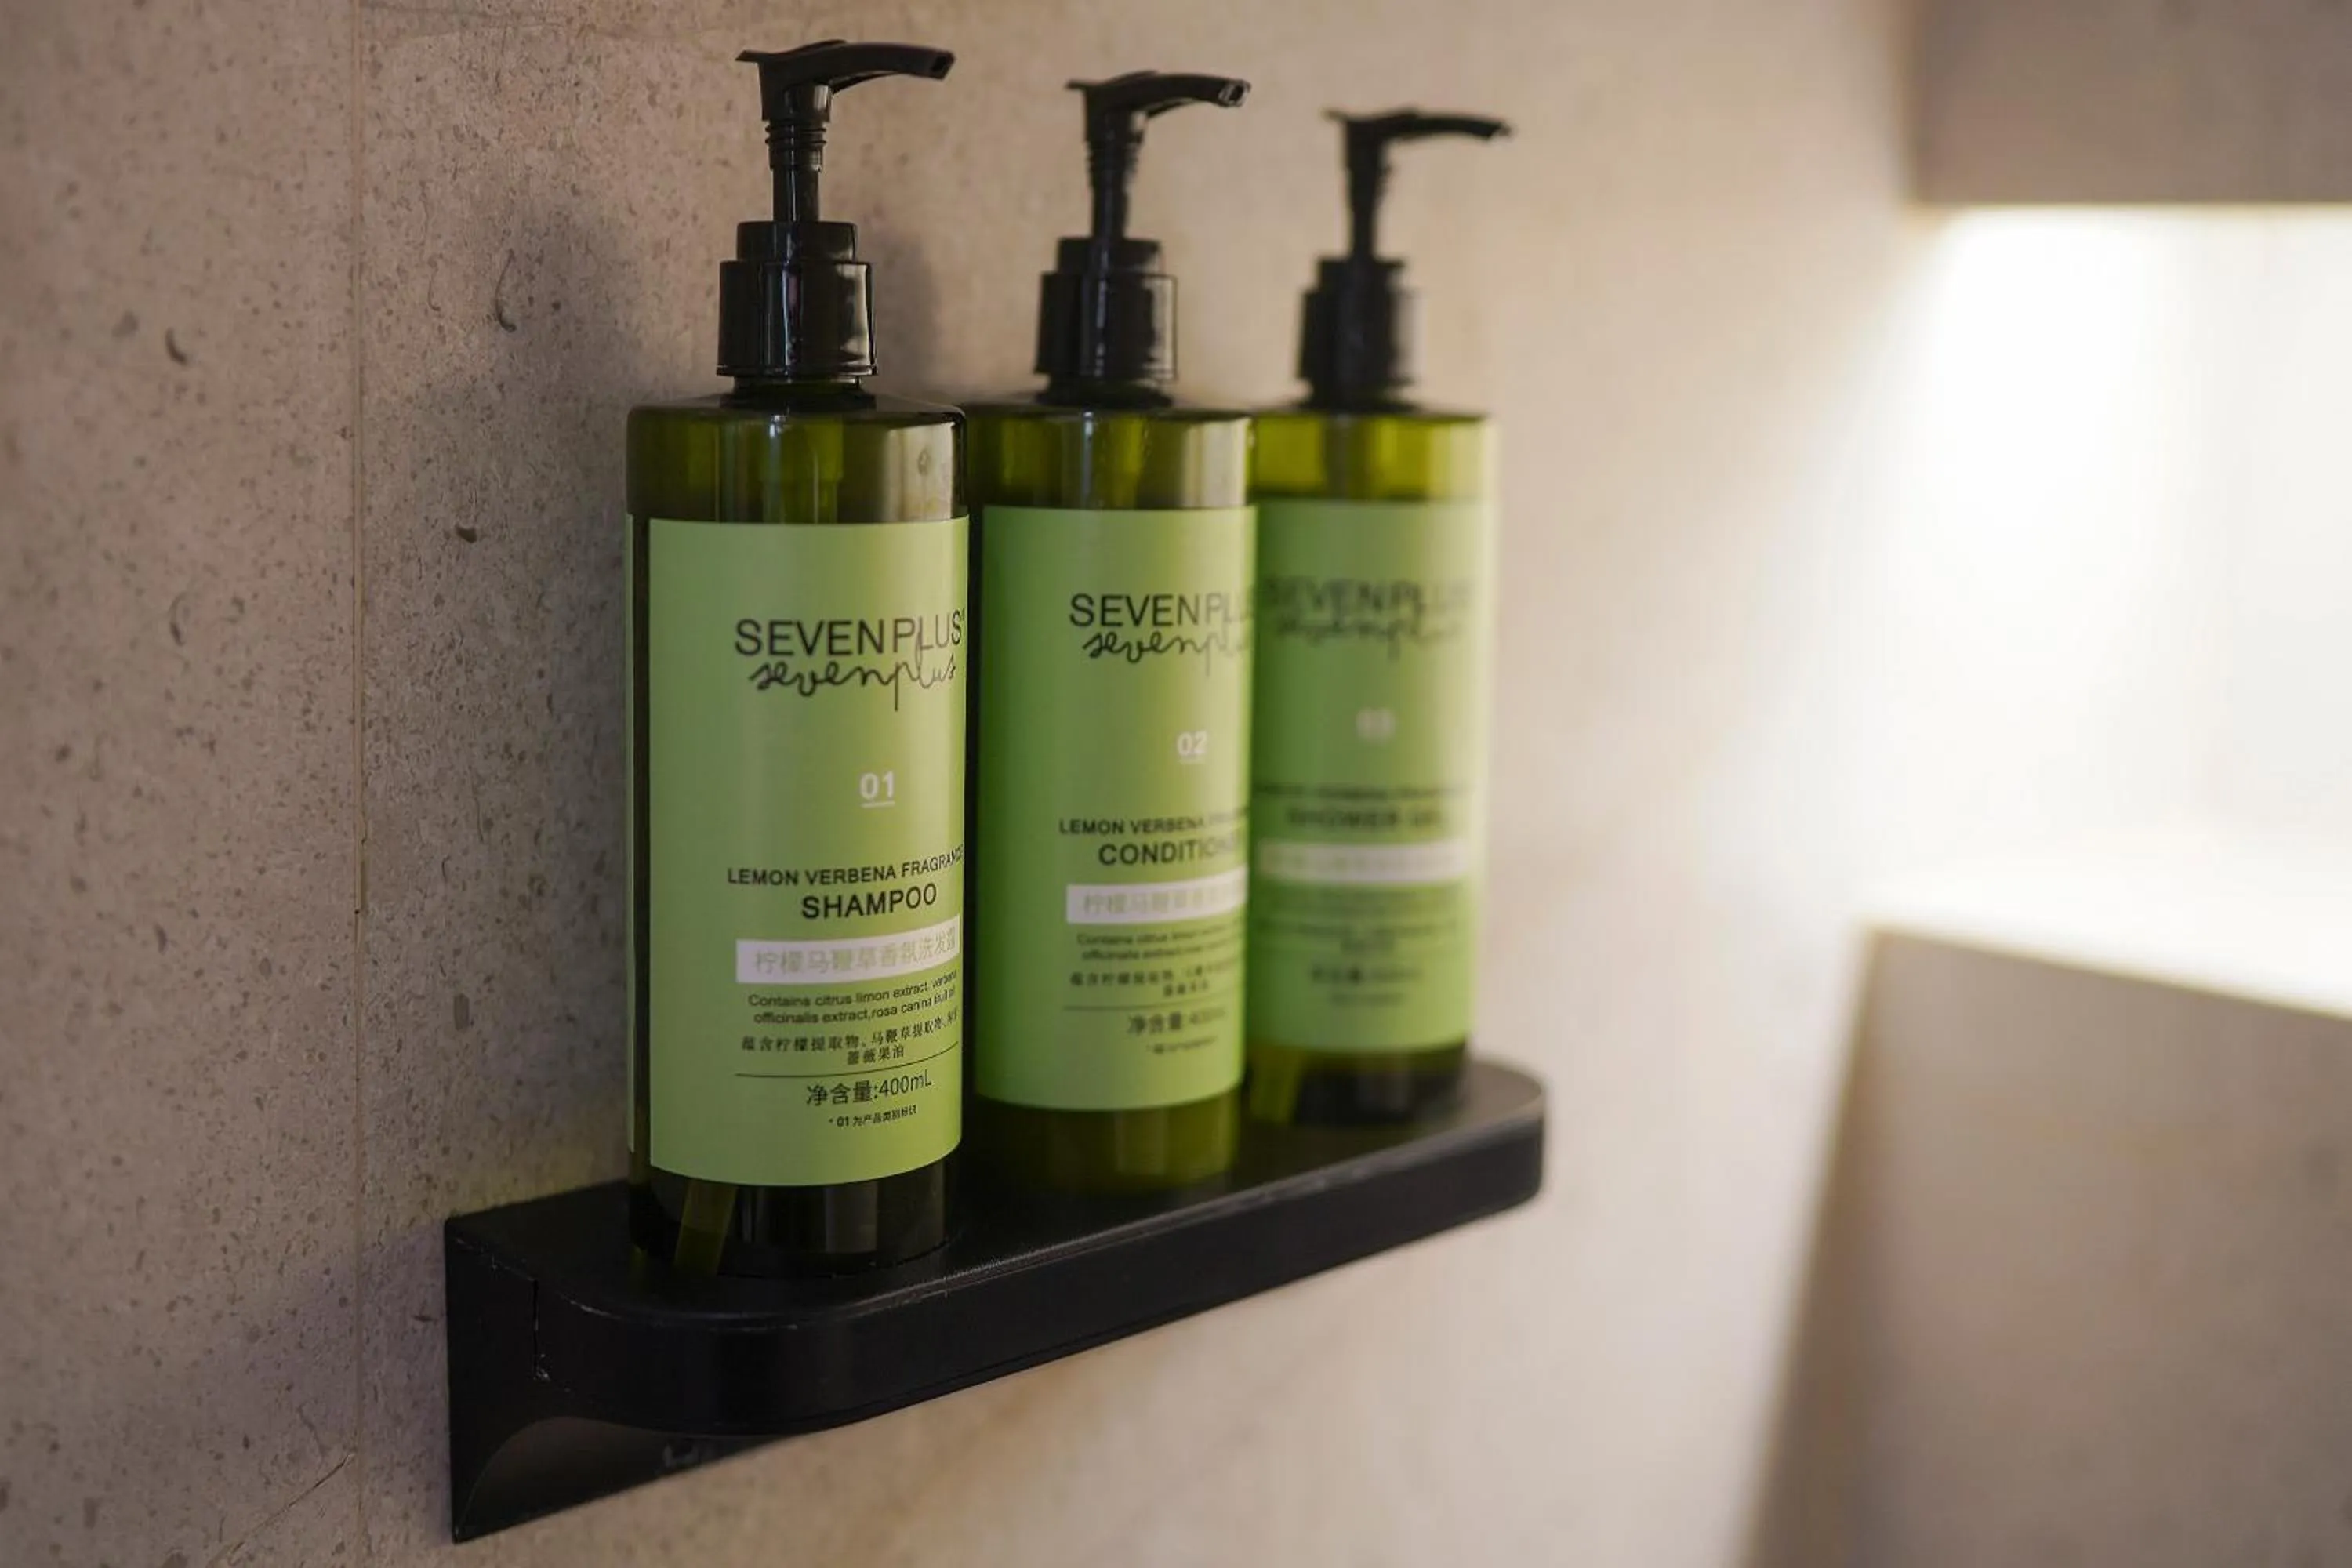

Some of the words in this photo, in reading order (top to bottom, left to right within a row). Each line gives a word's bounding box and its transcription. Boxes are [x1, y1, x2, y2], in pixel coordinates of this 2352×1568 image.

[748, 630, 957, 712] sevenplus
[1178, 730, 1208, 757] 02
[860, 771, 895, 800] 01
[1059, 819, 1124, 836] LEMON
[1129, 817, 1204, 835] VERBENA
[728, 867, 799, 886] LEMON
[805, 865, 897, 886] VERBENA
[801, 883, 938, 920] SHAMPOO
[748, 994, 811, 1007] Contains
[815, 993, 852, 1007] citrus
[855, 989, 890, 1004] limon
[754, 1011, 818, 1025] officinalis
